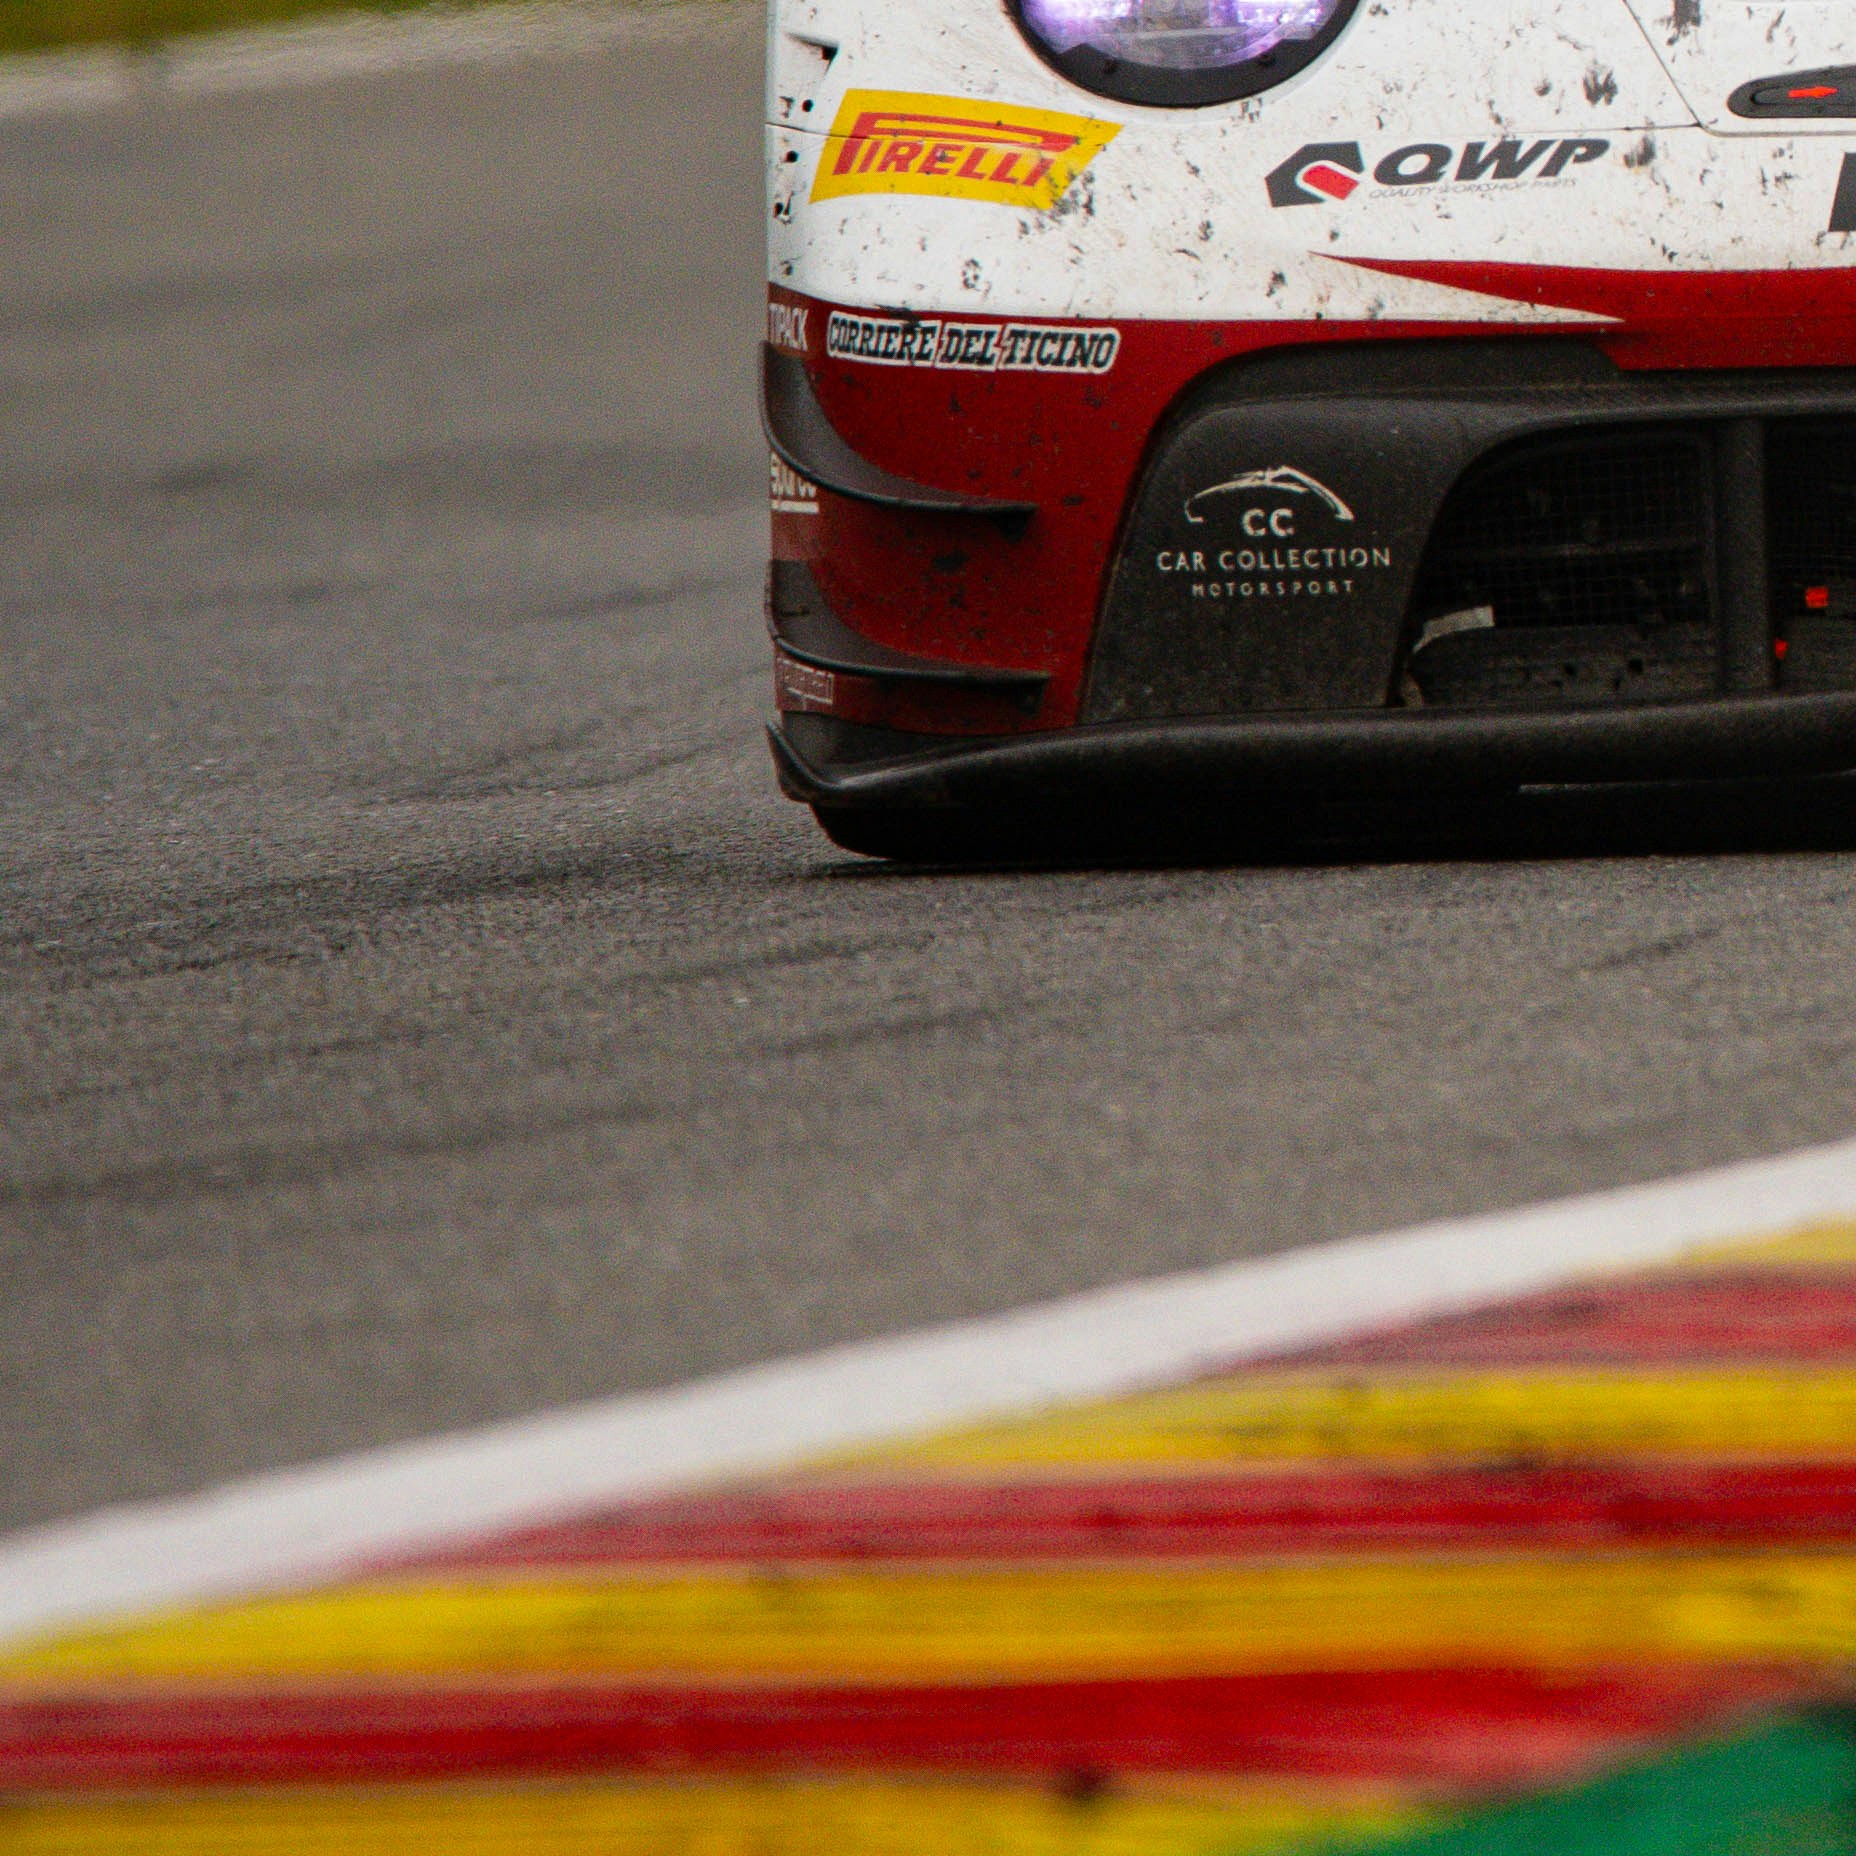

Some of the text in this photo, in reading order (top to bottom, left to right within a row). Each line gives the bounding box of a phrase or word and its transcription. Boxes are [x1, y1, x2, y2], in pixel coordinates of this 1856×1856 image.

[832, 112, 1076, 187] PIRELLI
[1372, 138, 1611, 186] QWP
[1368, 186, 1434, 200] QUALITY
[1439, 180, 1528, 195] WORKSHOP
[829, 315, 1116, 370] CORRIERE DEL TICINO
[1241, 508, 1296, 537] CC
[1156, 546, 1392, 572] CAR COLLECTION
[1191, 579, 1355, 597] MOTORSPORT
